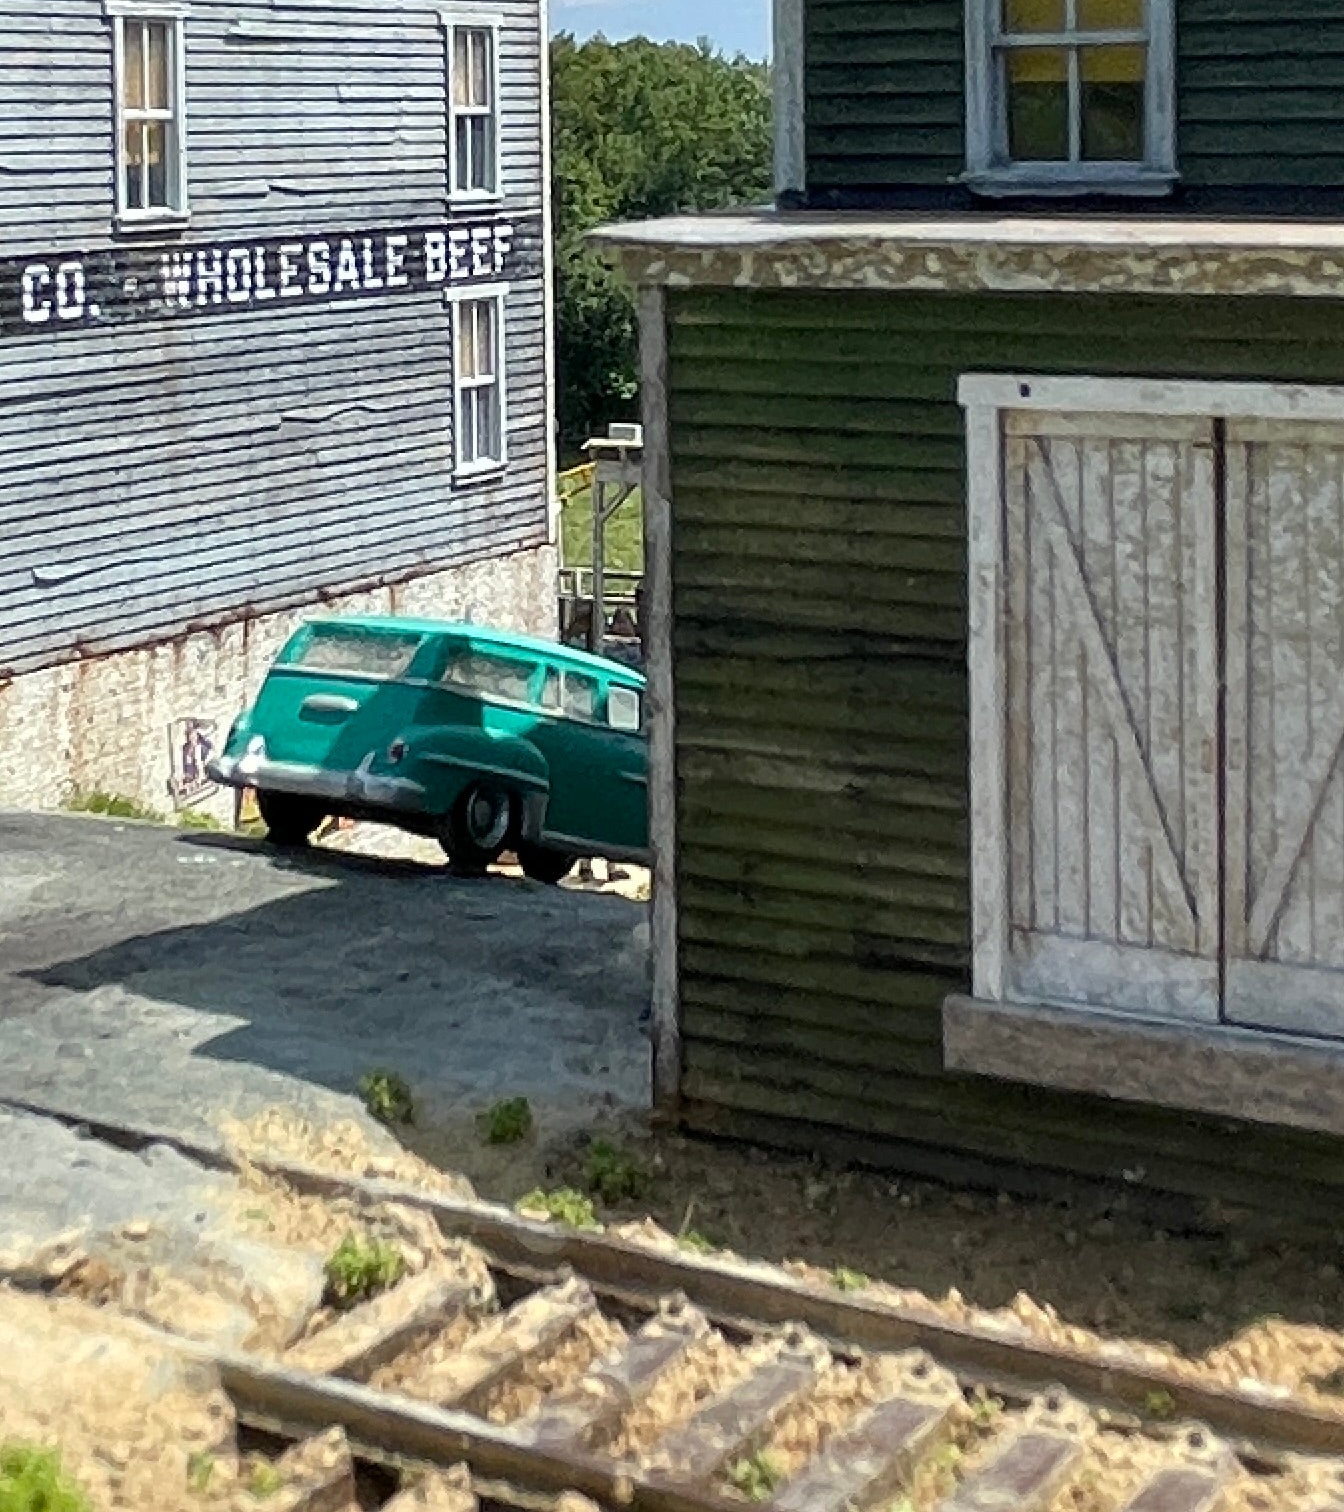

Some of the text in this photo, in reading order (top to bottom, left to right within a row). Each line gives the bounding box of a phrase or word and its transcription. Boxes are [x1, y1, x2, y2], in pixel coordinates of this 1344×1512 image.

[22, 261, 100, 322] CO.
[160, 234, 410, 308] WHOLESALE
[423, 224, 514, 283] BEEF
